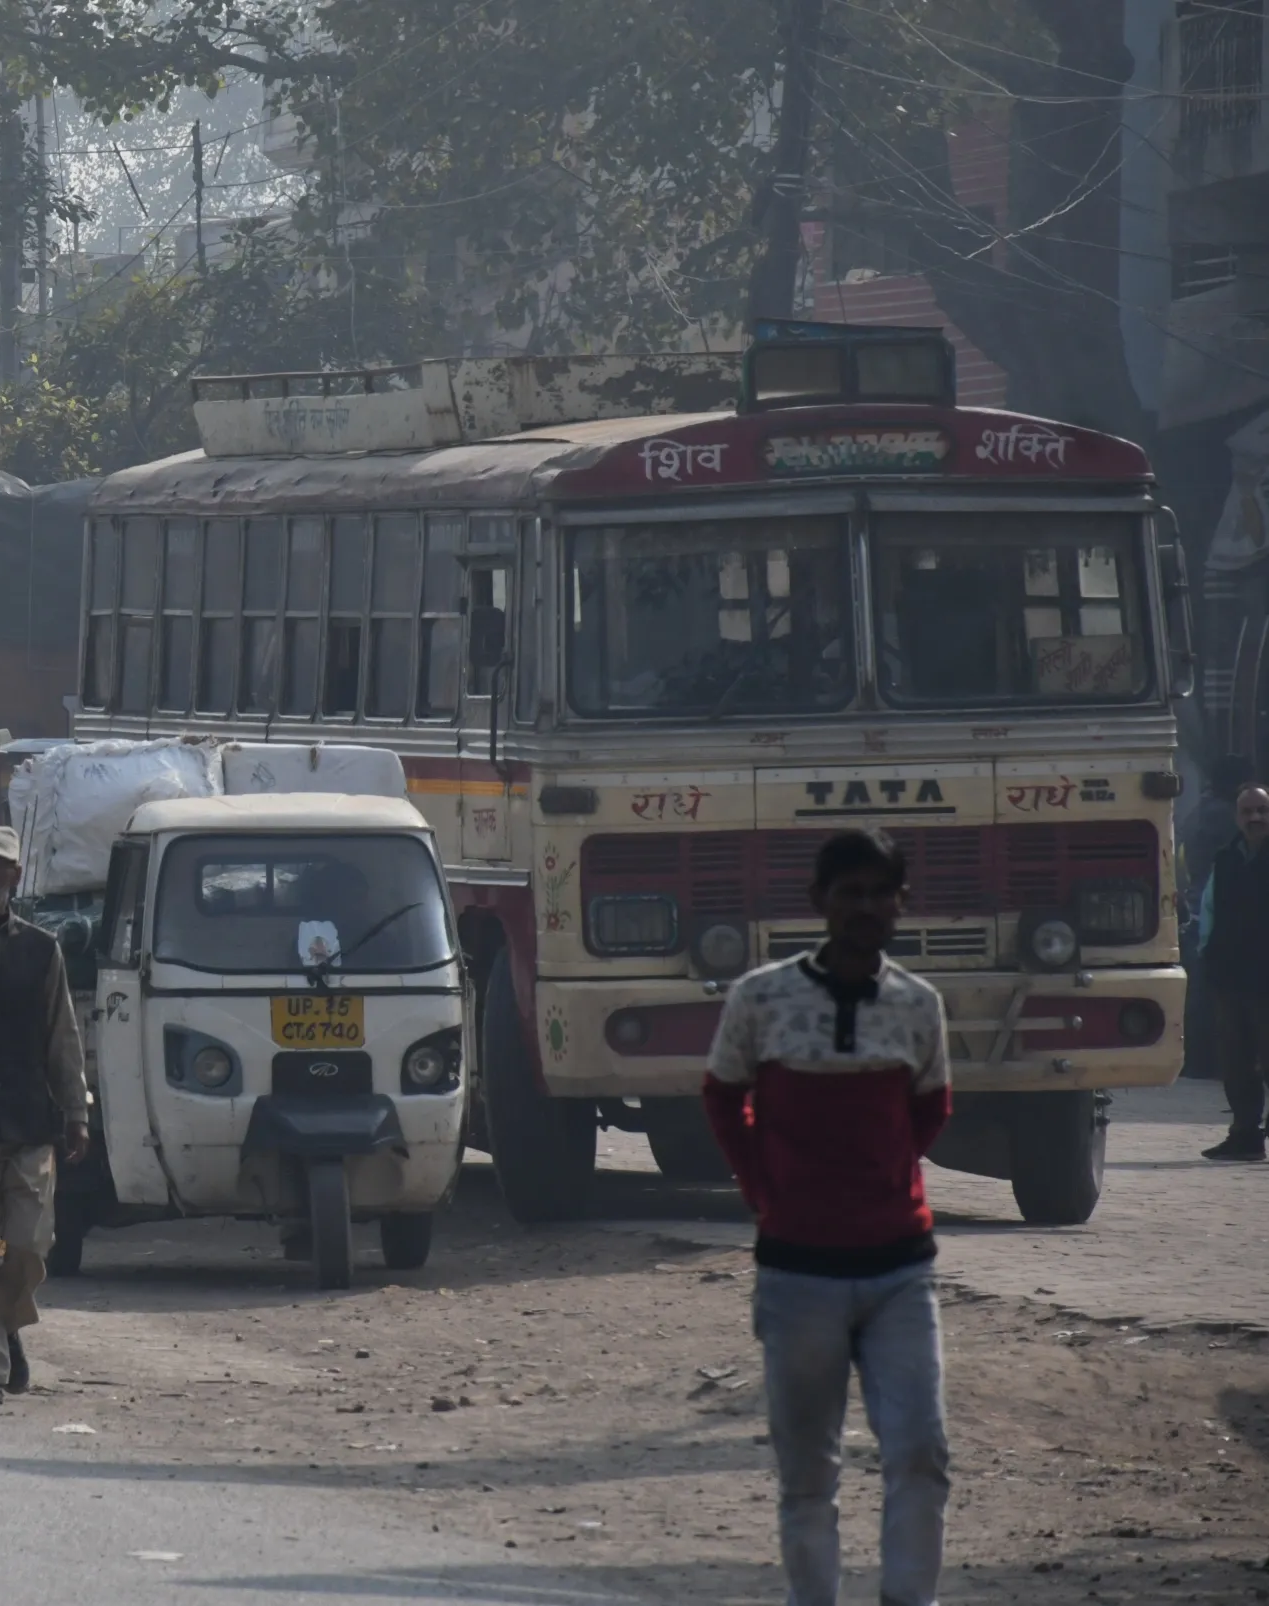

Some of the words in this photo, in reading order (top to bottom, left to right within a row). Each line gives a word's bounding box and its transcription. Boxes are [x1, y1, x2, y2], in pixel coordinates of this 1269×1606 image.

[638, 439, 729, 481] शिव
[975, 424, 1076, 469] शक्ति
[632, 784, 712, 821] राधे
[806, 780, 944, 805] TATA
[1006, 775, 1078, 812] राधे
